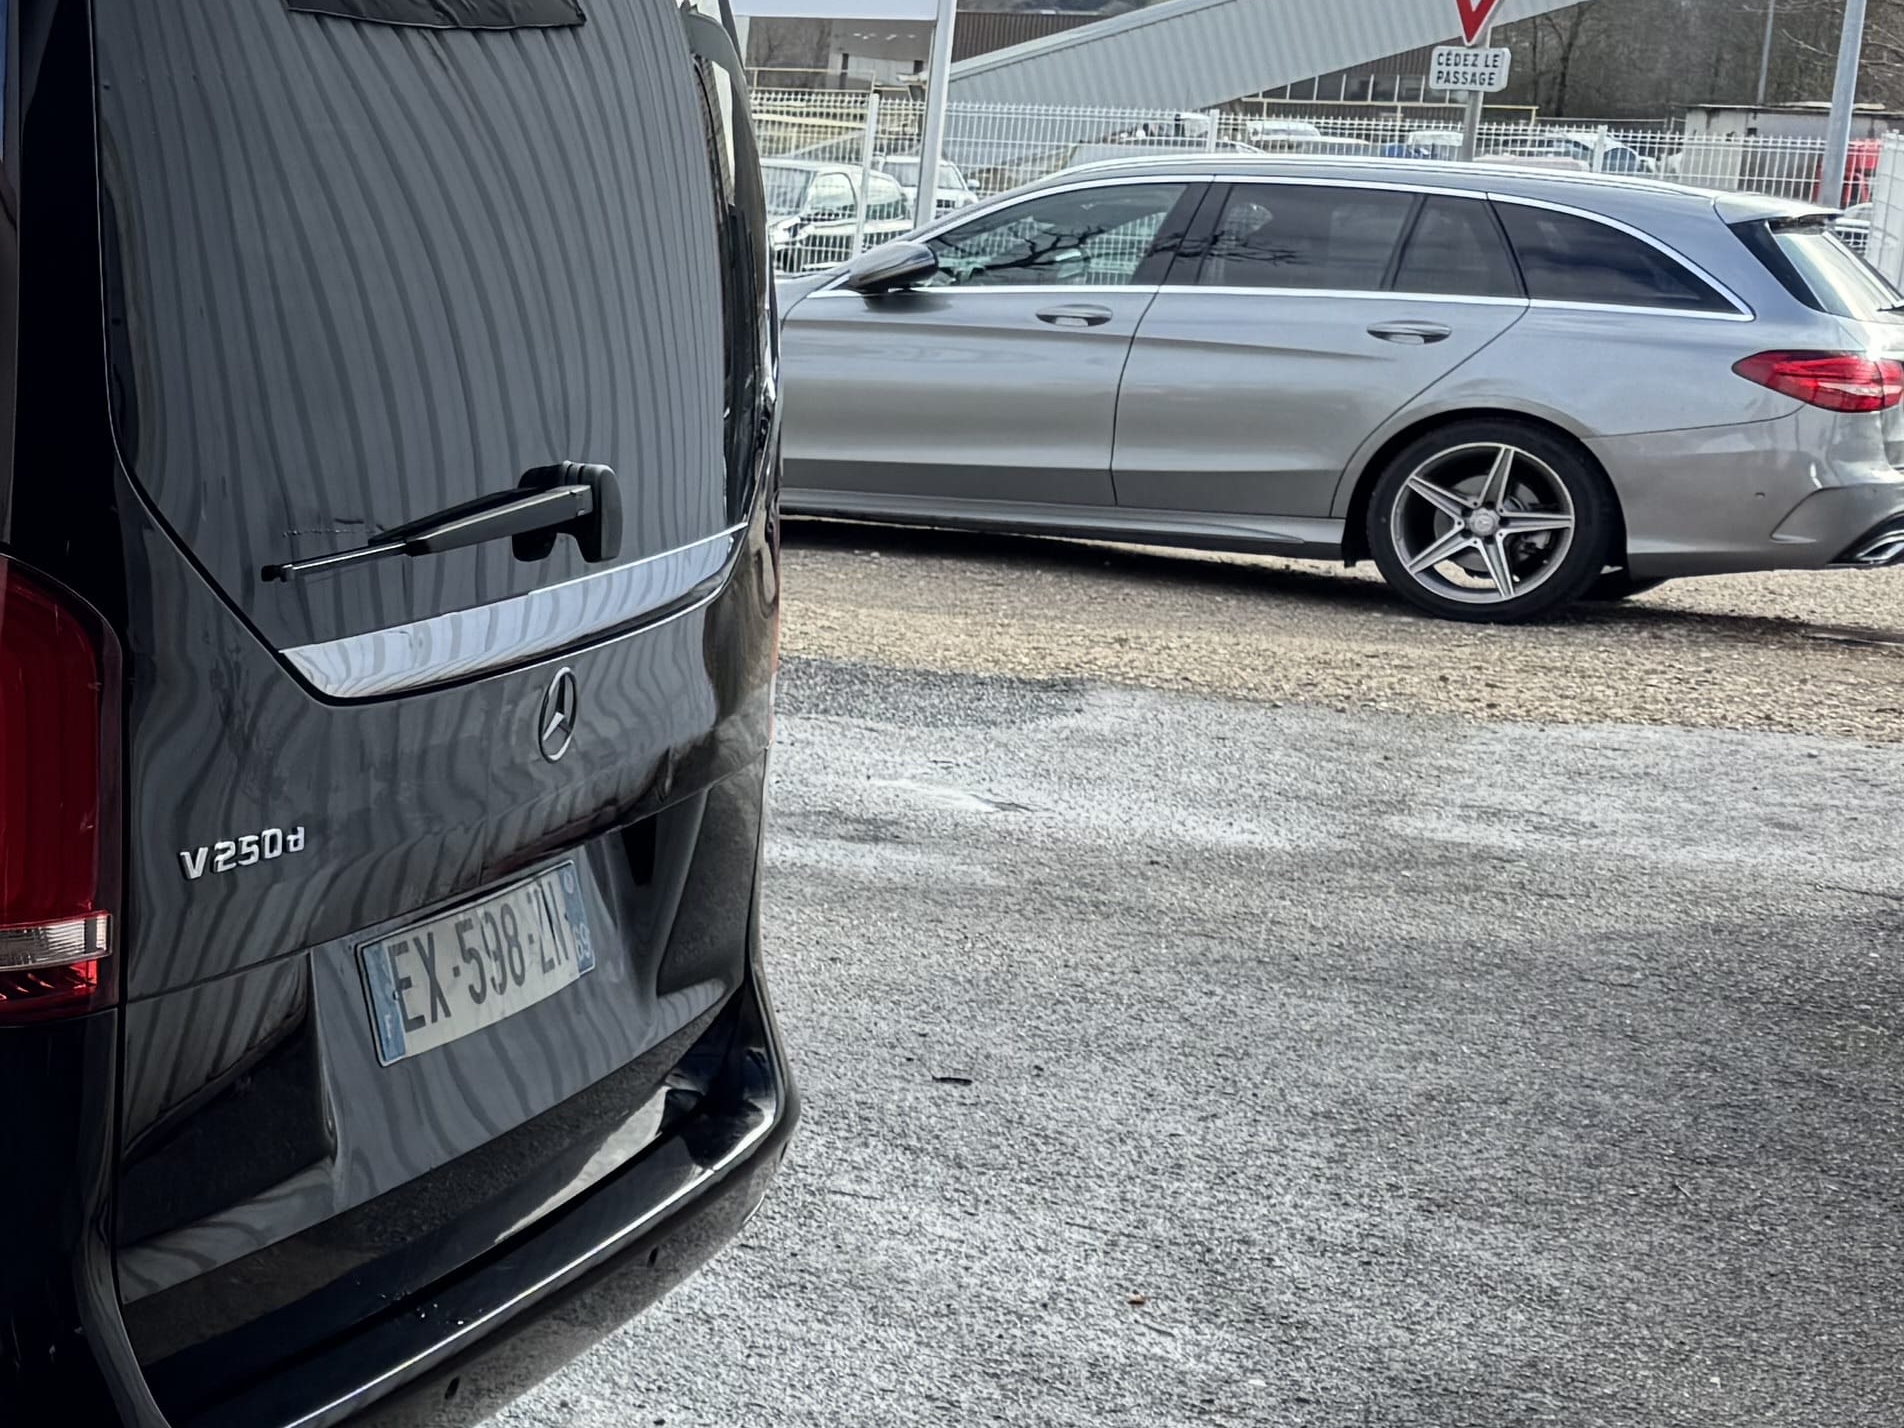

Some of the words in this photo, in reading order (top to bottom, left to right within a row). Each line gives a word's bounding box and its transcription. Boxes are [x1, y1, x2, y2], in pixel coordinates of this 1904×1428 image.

[1437, 50, 1479, 67] CÉDEZ
[1484, 53, 1500, 68] LE
[1436, 70, 1496, 86] PASSAGE
